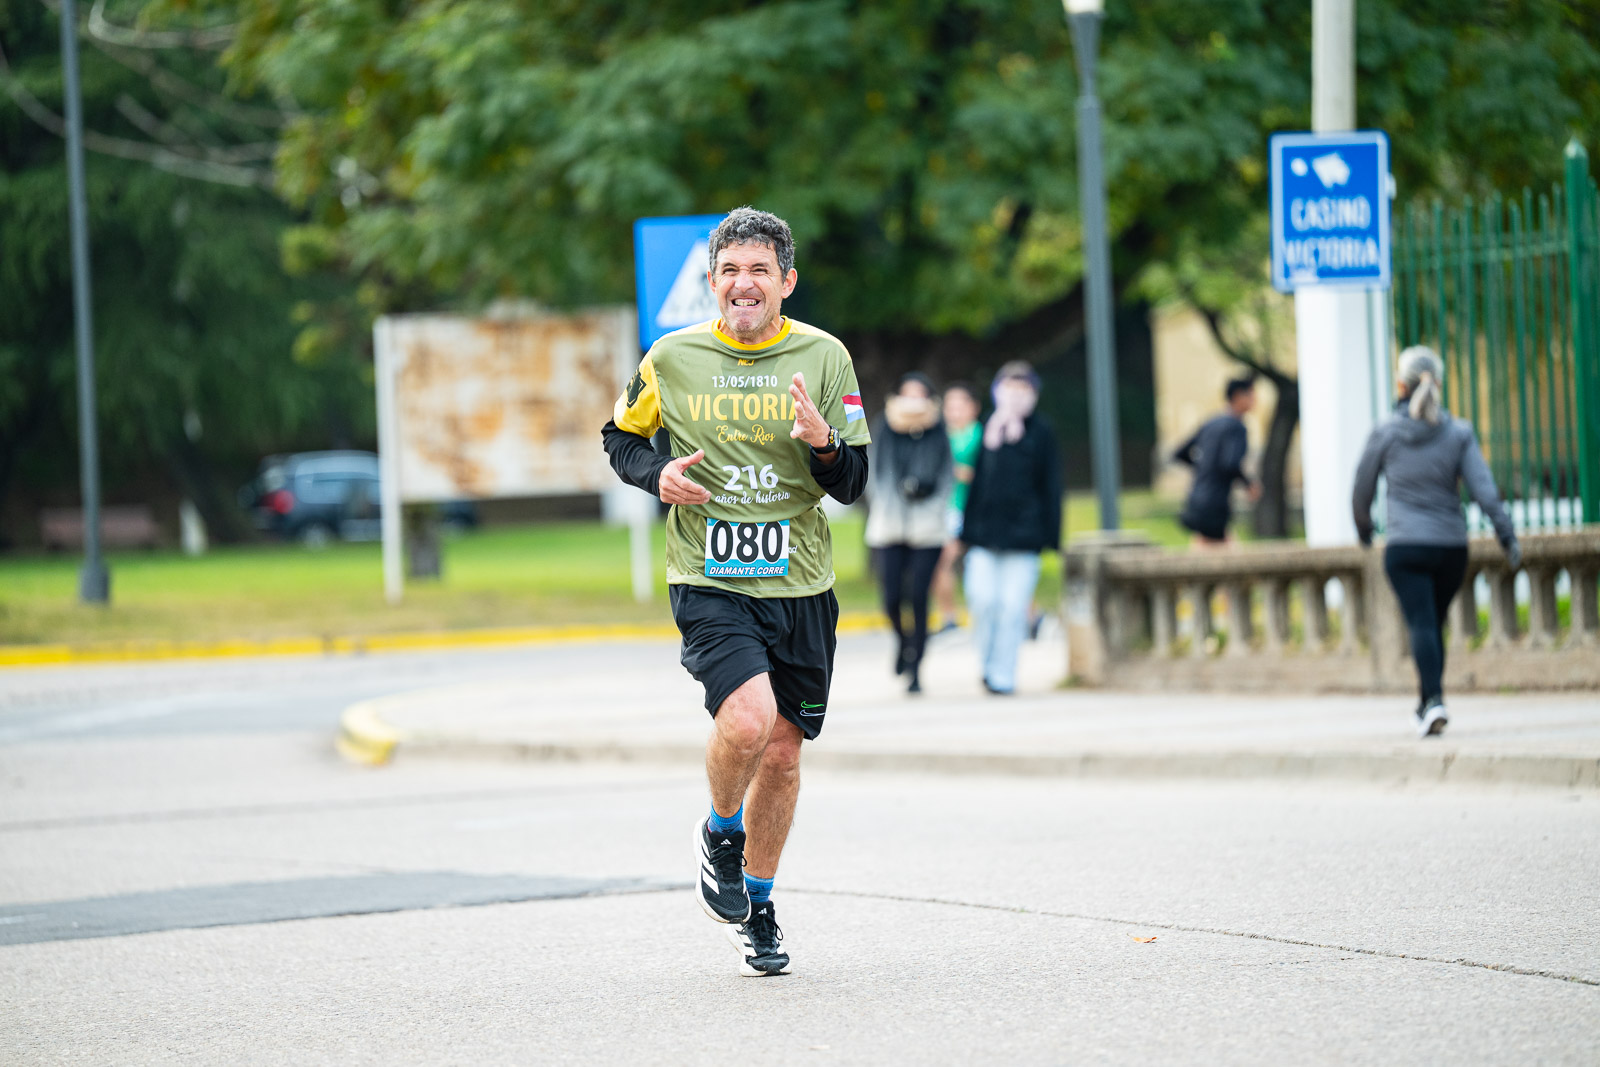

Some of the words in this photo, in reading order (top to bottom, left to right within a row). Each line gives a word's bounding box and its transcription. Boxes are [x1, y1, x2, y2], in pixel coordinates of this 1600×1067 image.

[1290, 196, 1372, 231] CASINO
[1286, 237, 1379, 269] VICTORIA
[712, 375, 778, 388] 13/05/1810
[715, 425, 748, 444] Entre
[722, 464, 779, 491] 216
[715, 494, 739, 504] años
[740, 491, 753, 504] de
[755, 490, 791, 504] historia
[711, 520, 783, 563] 080
[709, 567, 756, 575] DIAMANTE
[756, 566, 786, 575] CORRE
